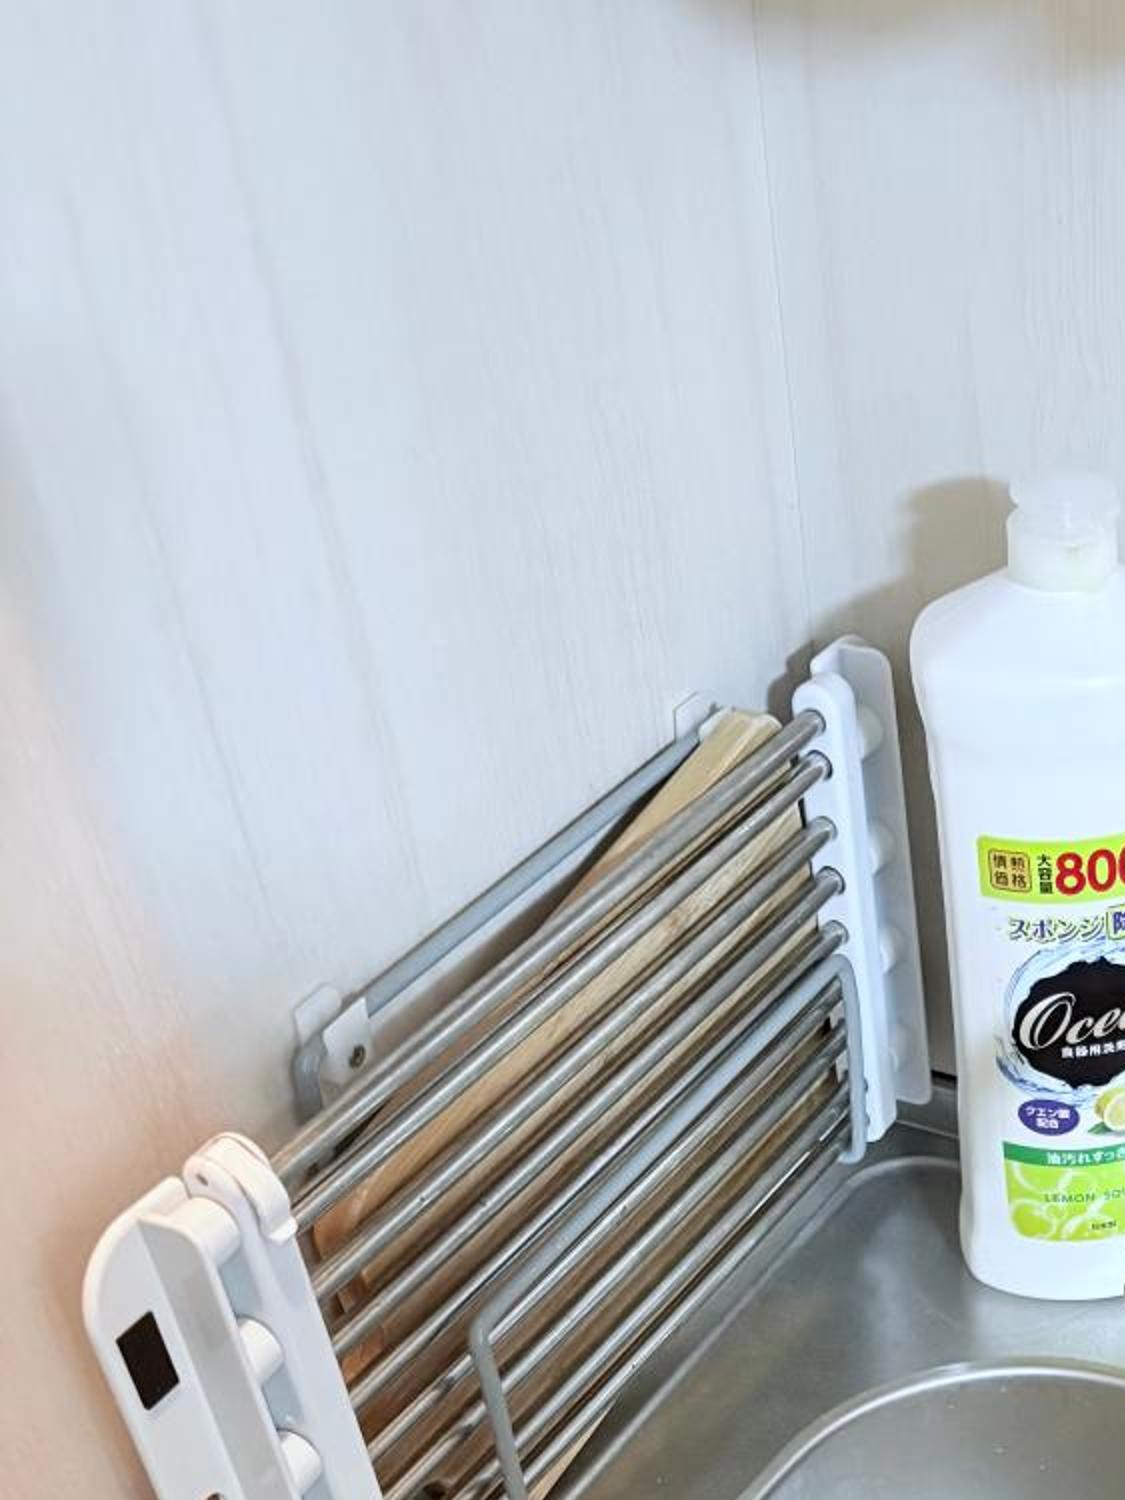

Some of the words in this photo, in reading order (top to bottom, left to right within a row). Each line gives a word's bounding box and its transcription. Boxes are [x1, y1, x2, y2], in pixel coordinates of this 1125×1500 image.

[1037, 853, 1053, 894] 大容量
[1044, 1192, 1096, 1204] LEMON
